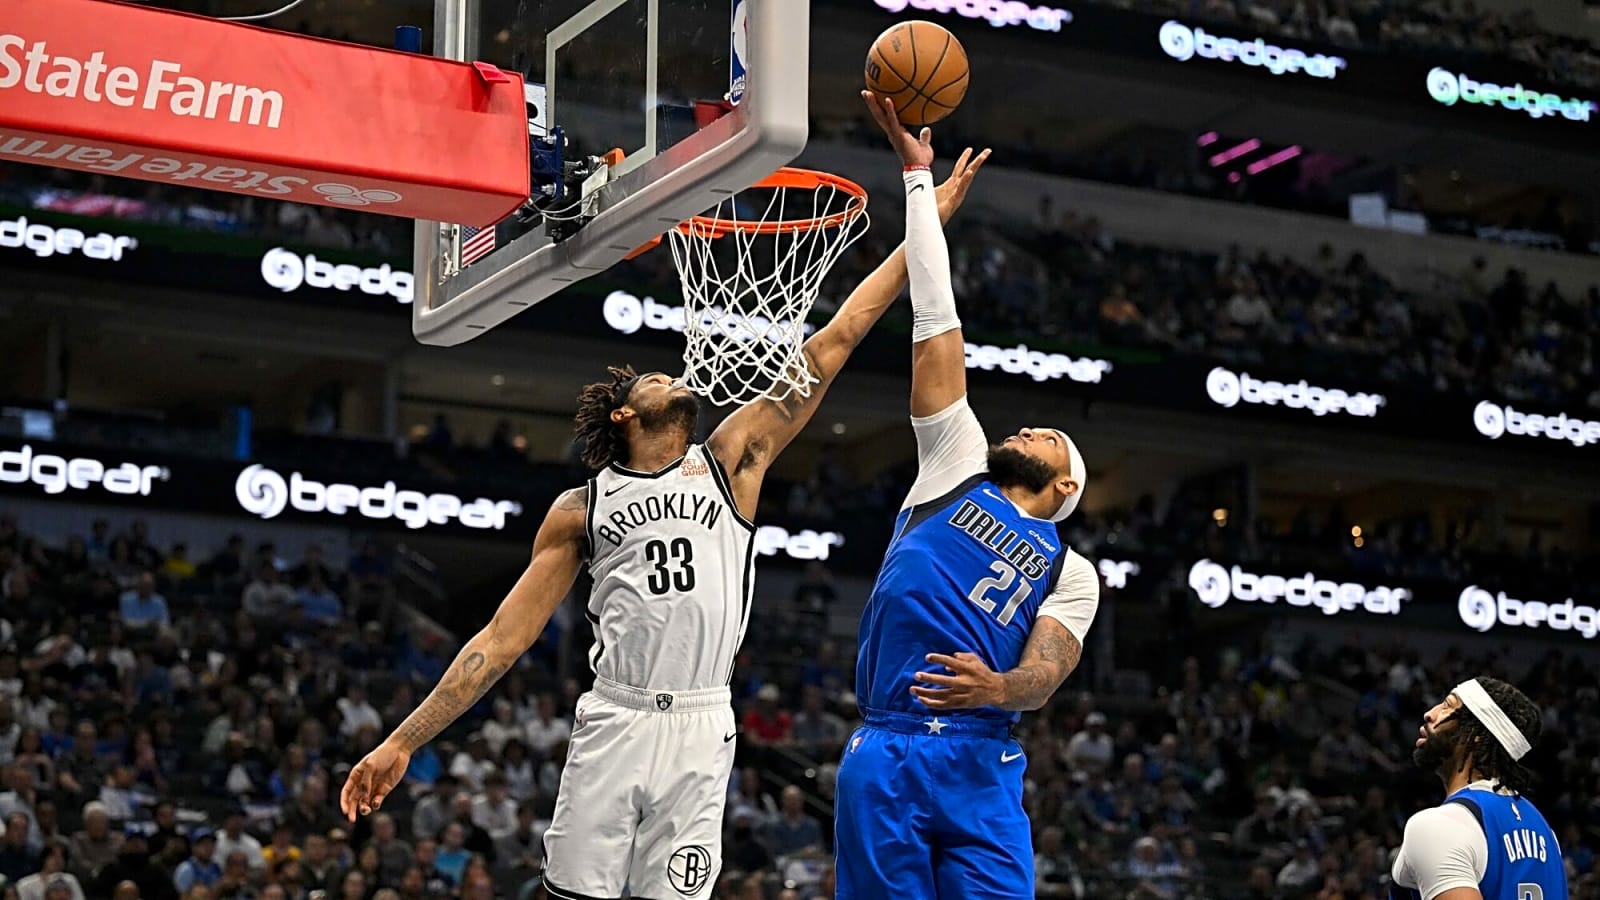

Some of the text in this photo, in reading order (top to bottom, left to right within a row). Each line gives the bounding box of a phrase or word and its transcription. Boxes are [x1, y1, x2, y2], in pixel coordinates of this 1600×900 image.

[1194, 27, 1342, 79] bedgear
[1459, 73, 1596, 122] bedgear
[1240, 372, 1383, 417] bedgear
[290, 471, 517, 530] bedgear
[598, 493, 723, 547] BROOKLYN
[948, 499, 1050, 581] DALLAS
[1028, 529, 1056, 553] chime
[645, 537, 695, 595] 33
[1231, 564, 1406, 615] bedgear
[967, 559, 1033, 627] 21
[1497, 591, 1600, 639] bedg
[684, 852, 699, 887] B
[1503, 828, 1547, 863] DAVIS
